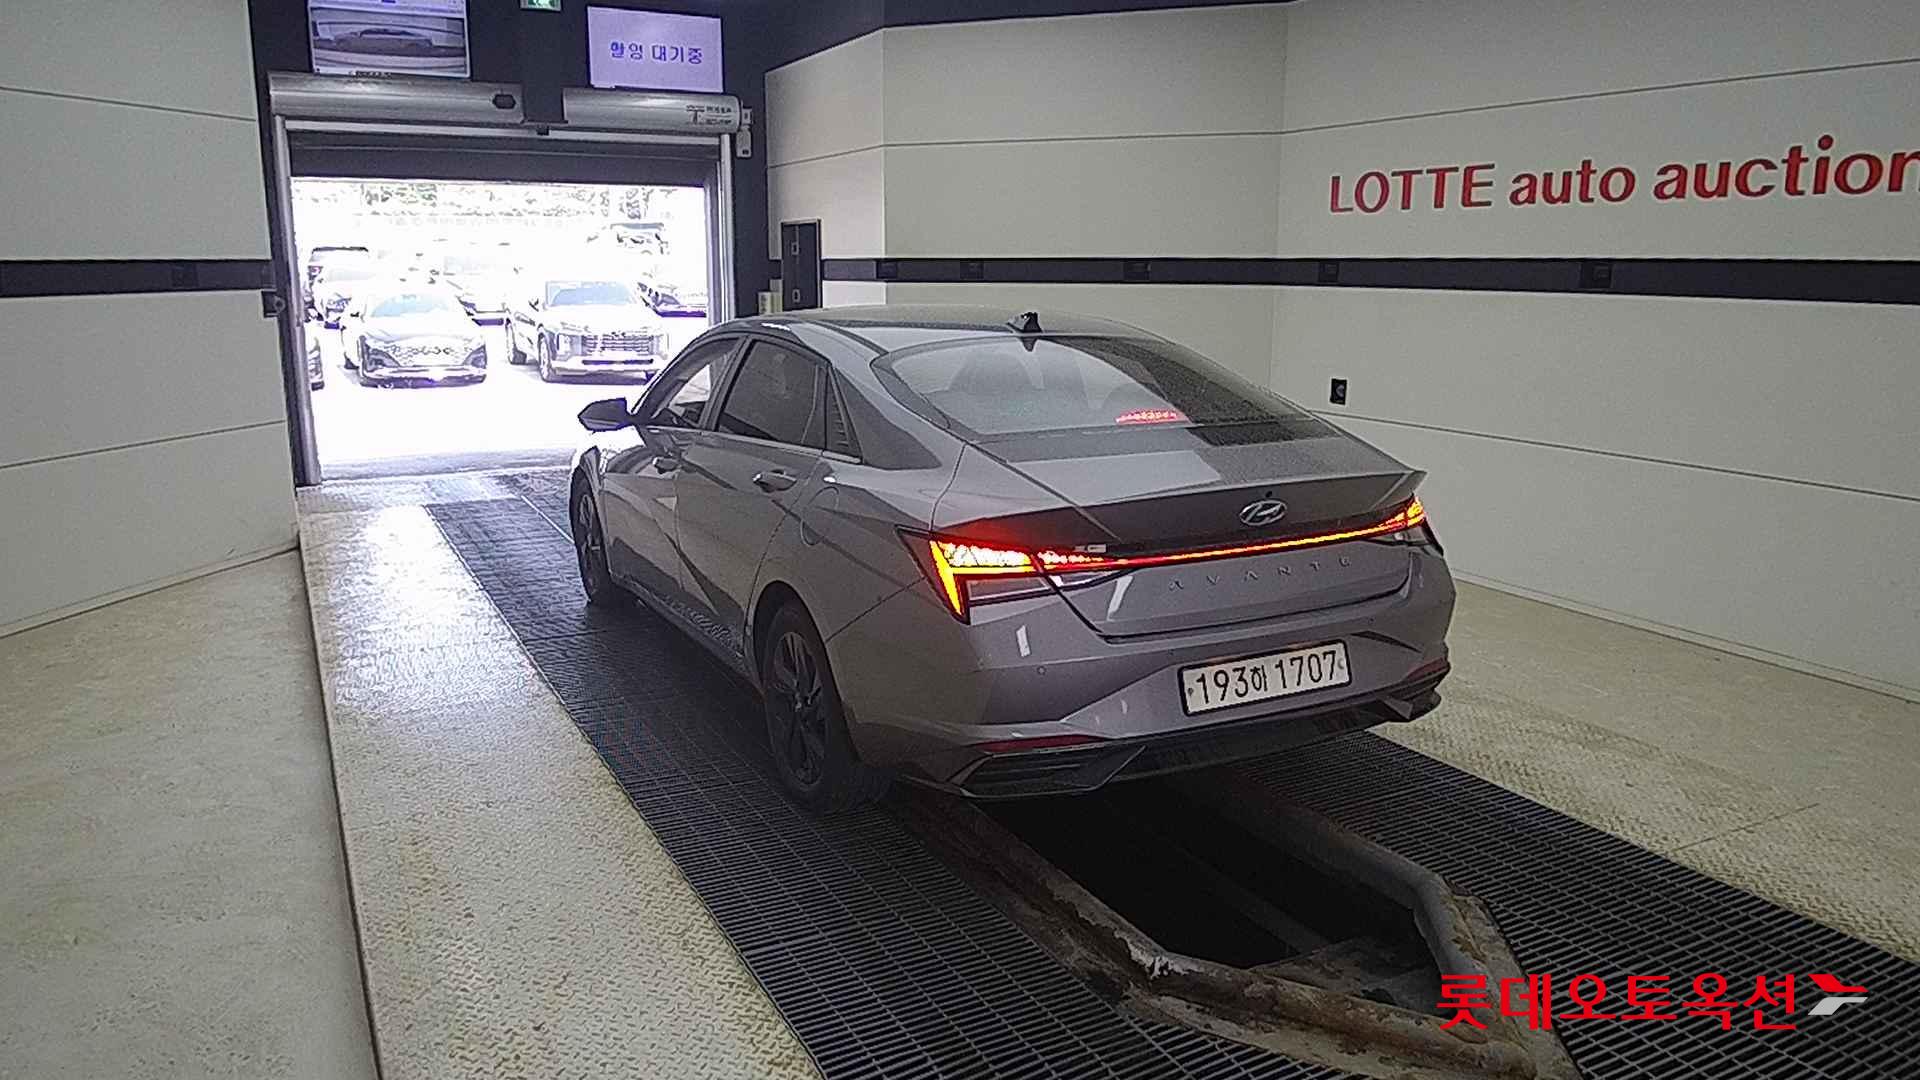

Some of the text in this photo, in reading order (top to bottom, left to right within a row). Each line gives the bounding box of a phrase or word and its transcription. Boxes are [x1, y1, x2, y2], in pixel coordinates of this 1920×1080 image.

[651, 44, 702, 65] 대기중
[1330, 134, 1920, 213] LOTTE auto auction
[1168, 555, 1351, 592] AVANTE
[1274, 650, 1337, 689] 1707
